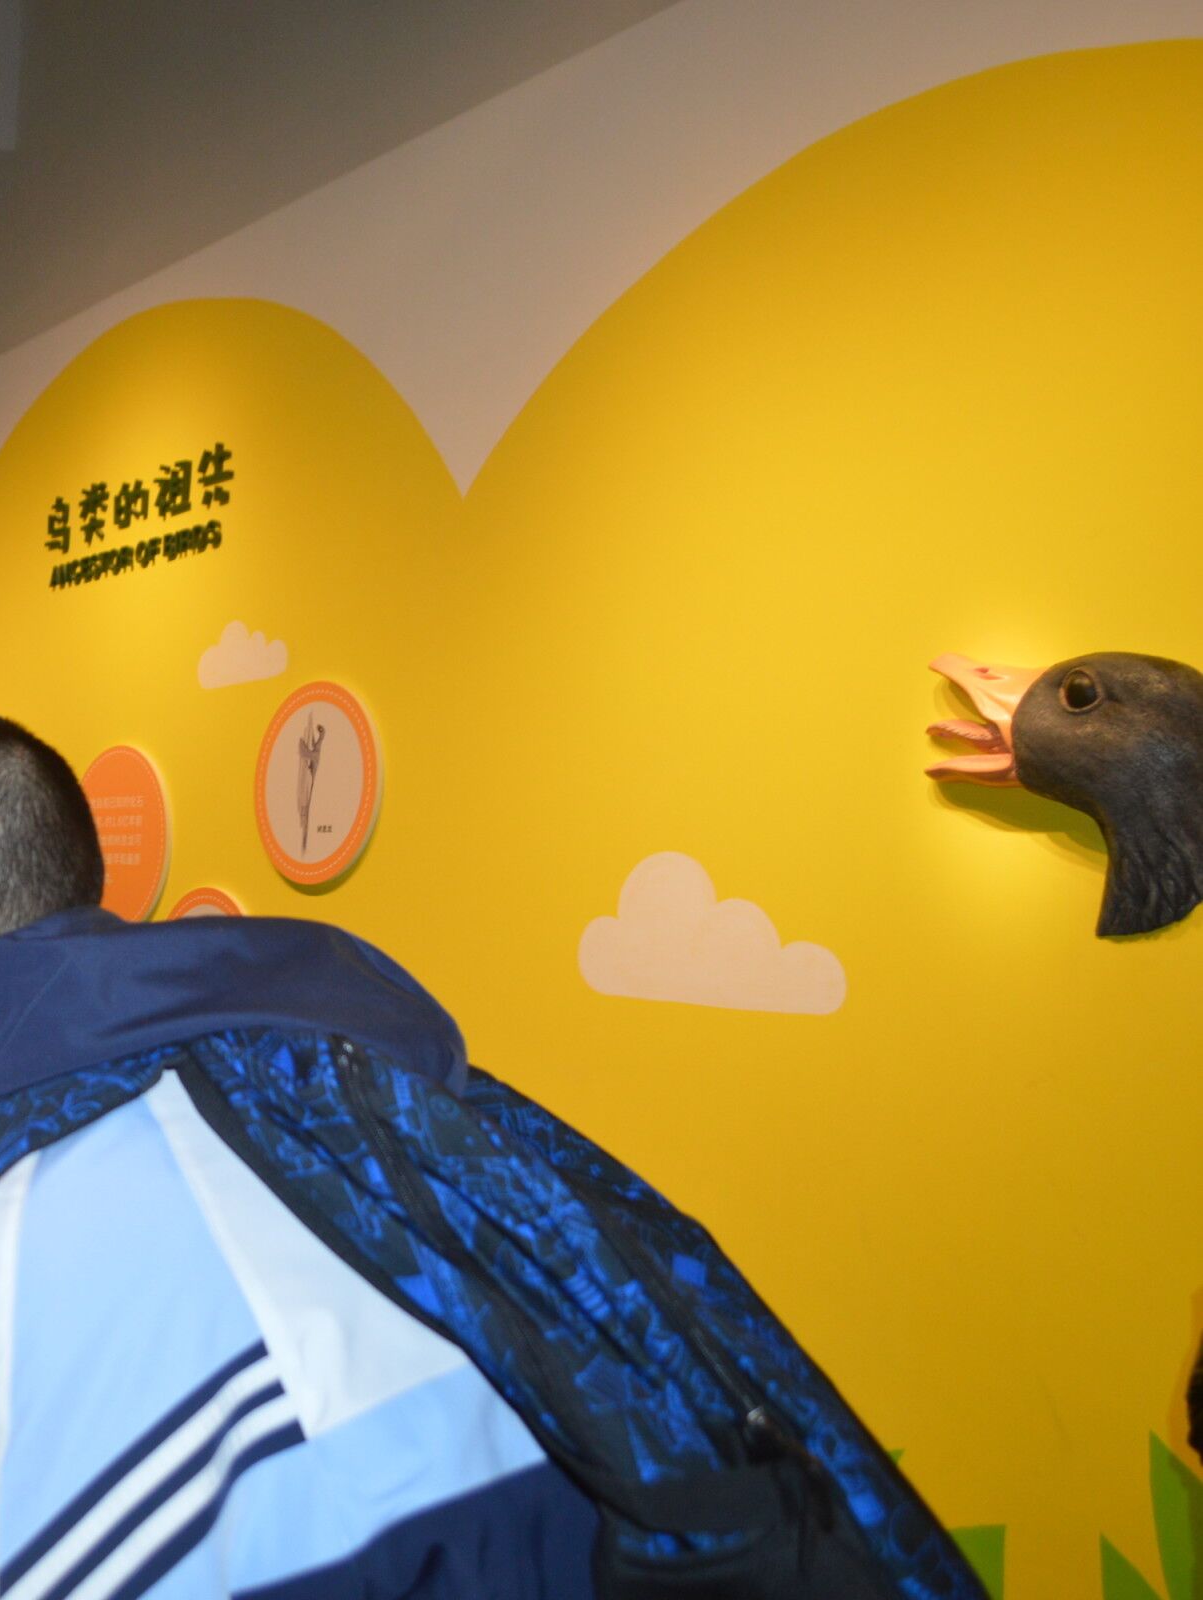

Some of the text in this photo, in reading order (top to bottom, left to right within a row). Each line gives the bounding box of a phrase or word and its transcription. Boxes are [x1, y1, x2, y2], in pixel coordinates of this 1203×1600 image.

[45, 442, 234, 554] 鸟类的祖先
[135, 537, 162, 568] OF
[162, 519, 222, 562] BIRDS
